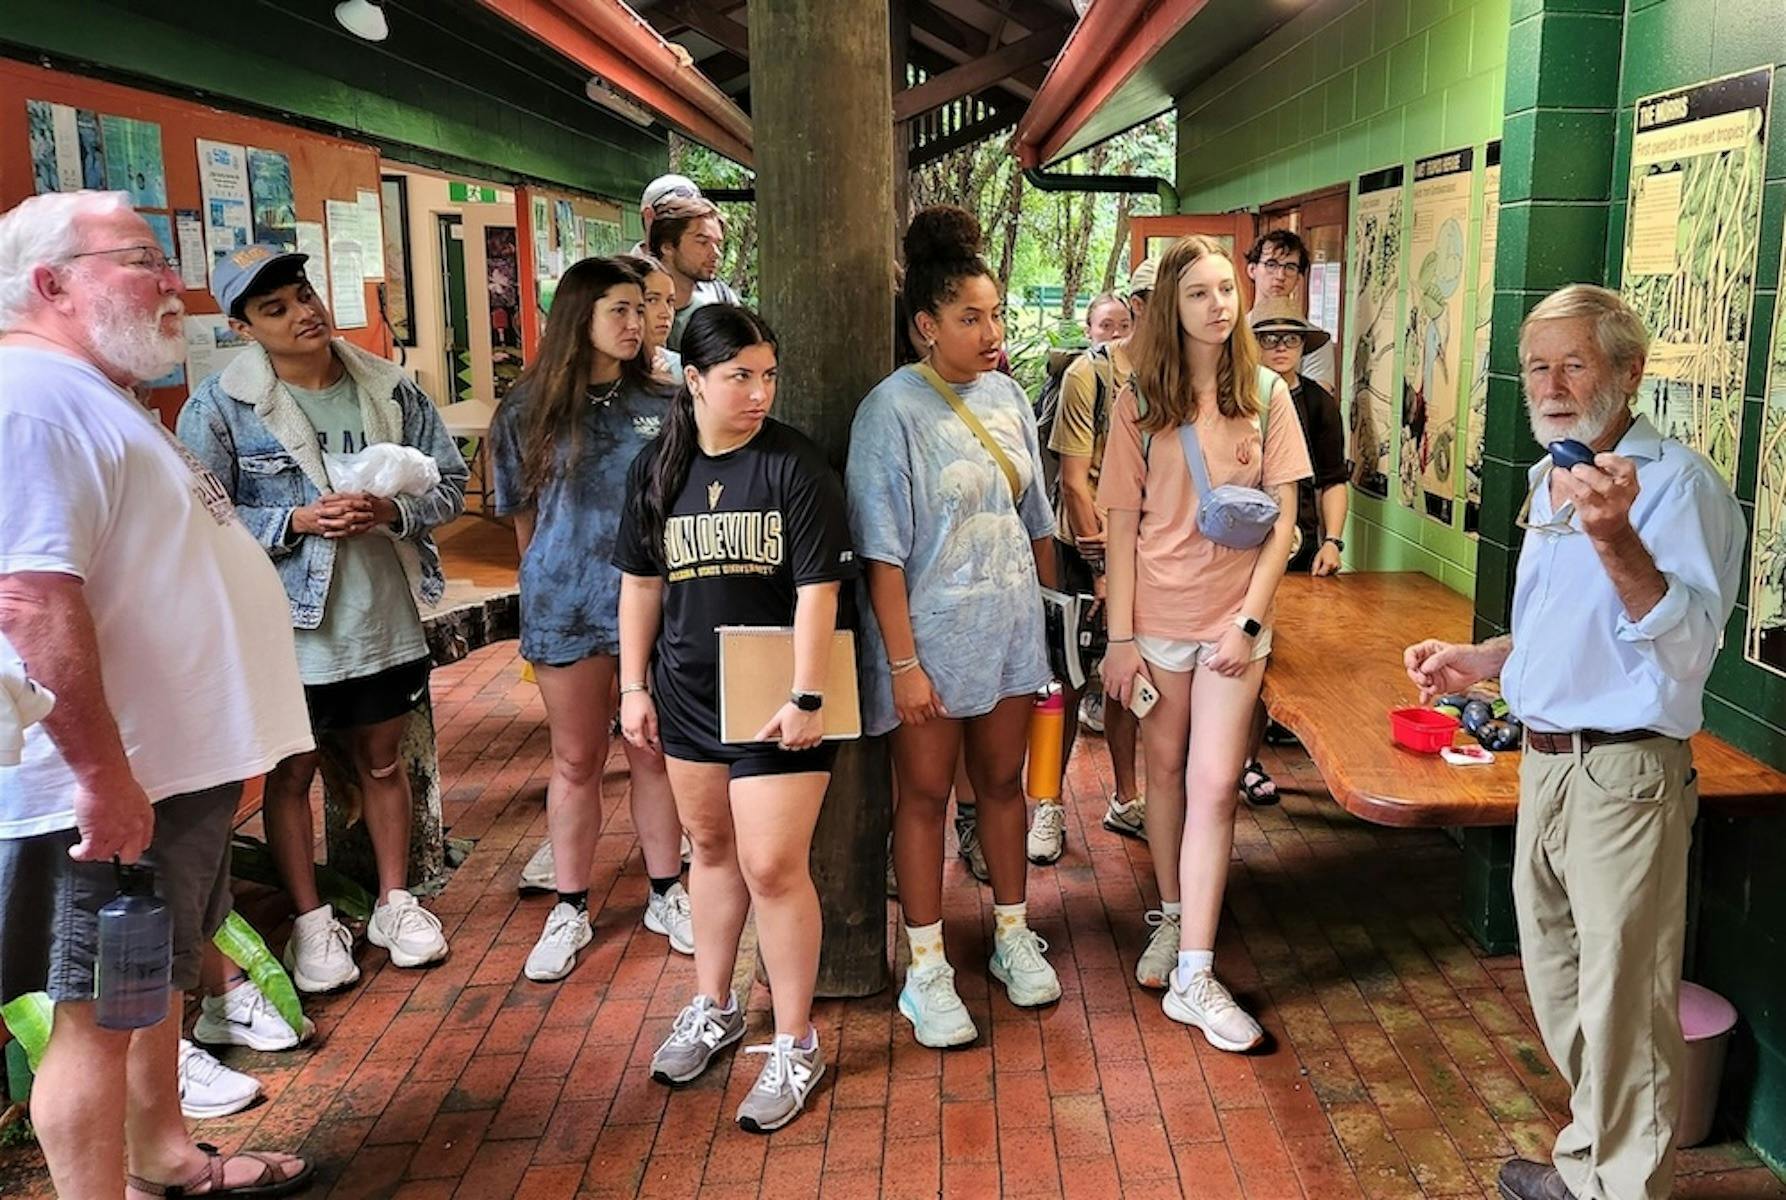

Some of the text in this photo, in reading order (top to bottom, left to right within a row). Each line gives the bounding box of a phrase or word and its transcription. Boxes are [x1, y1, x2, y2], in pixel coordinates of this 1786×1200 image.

[1679, 133, 1687, 149] of
[1687, 133, 1700, 147] the
[1716, 125, 1745, 144] tropics
[664, 511, 783, 569] UNDEVILS
